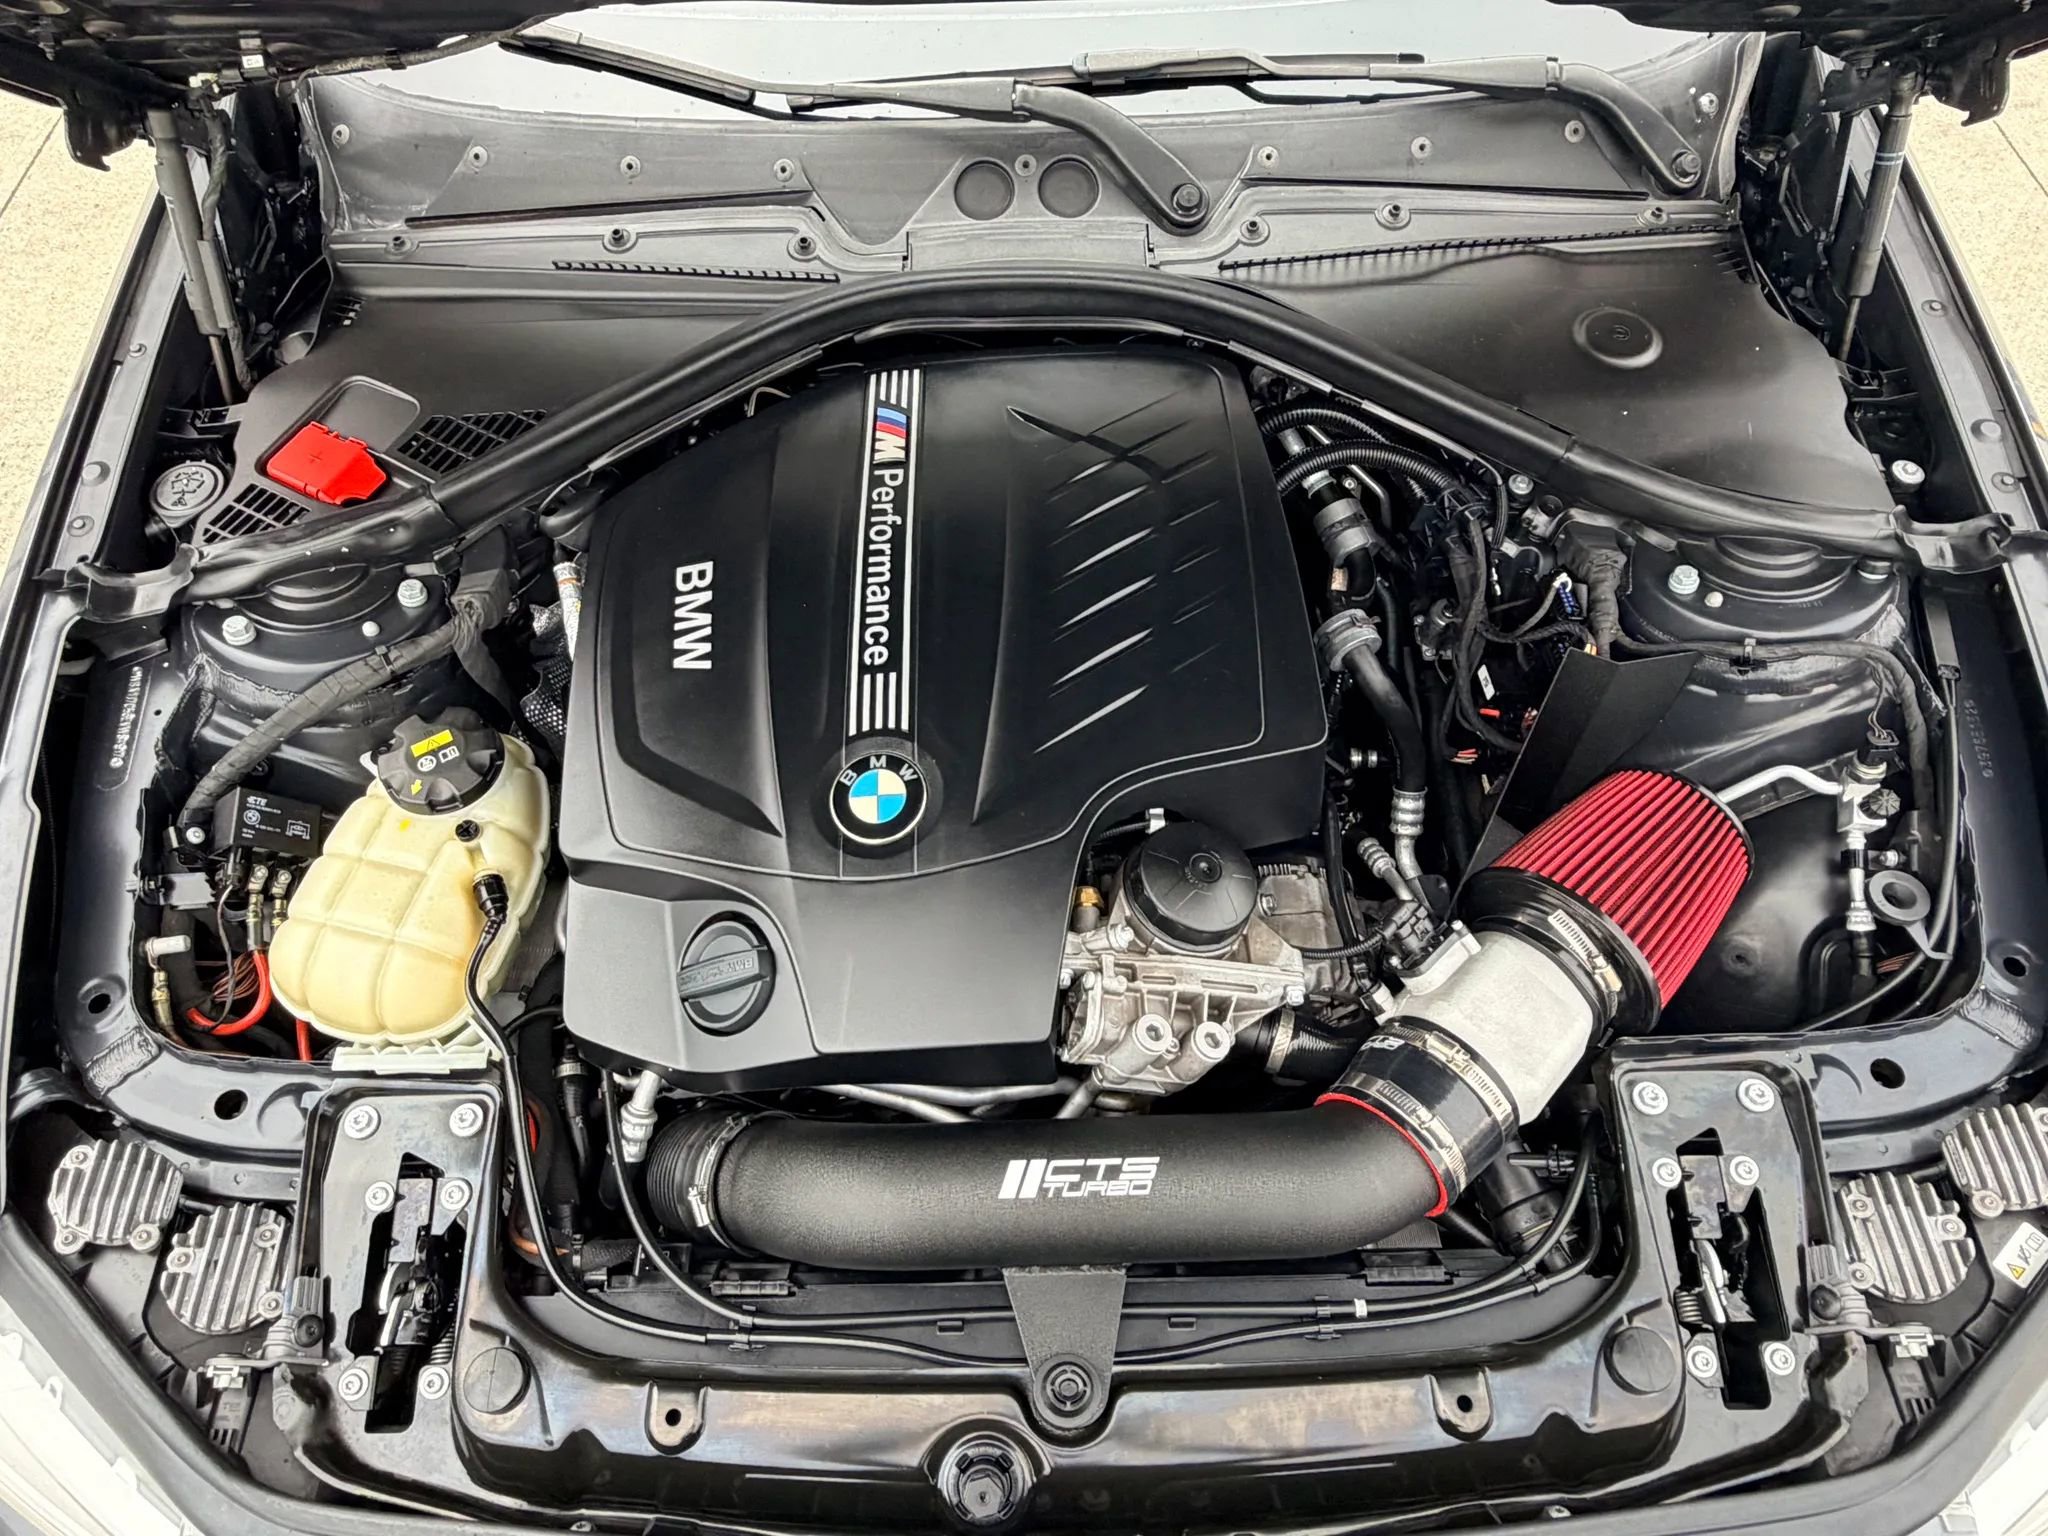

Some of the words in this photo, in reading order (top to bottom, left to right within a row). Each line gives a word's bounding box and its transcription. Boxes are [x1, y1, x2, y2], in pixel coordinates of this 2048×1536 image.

[873, 428, 907, 464] M
[863, 468, 904, 666] Performance
[673, 561, 714, 669] BMW
[839, 754, 919, 787] BMW
[1044, 1156, 1161, 1182] CTS
[1042, 1179, 1153, 1198] TURBO
